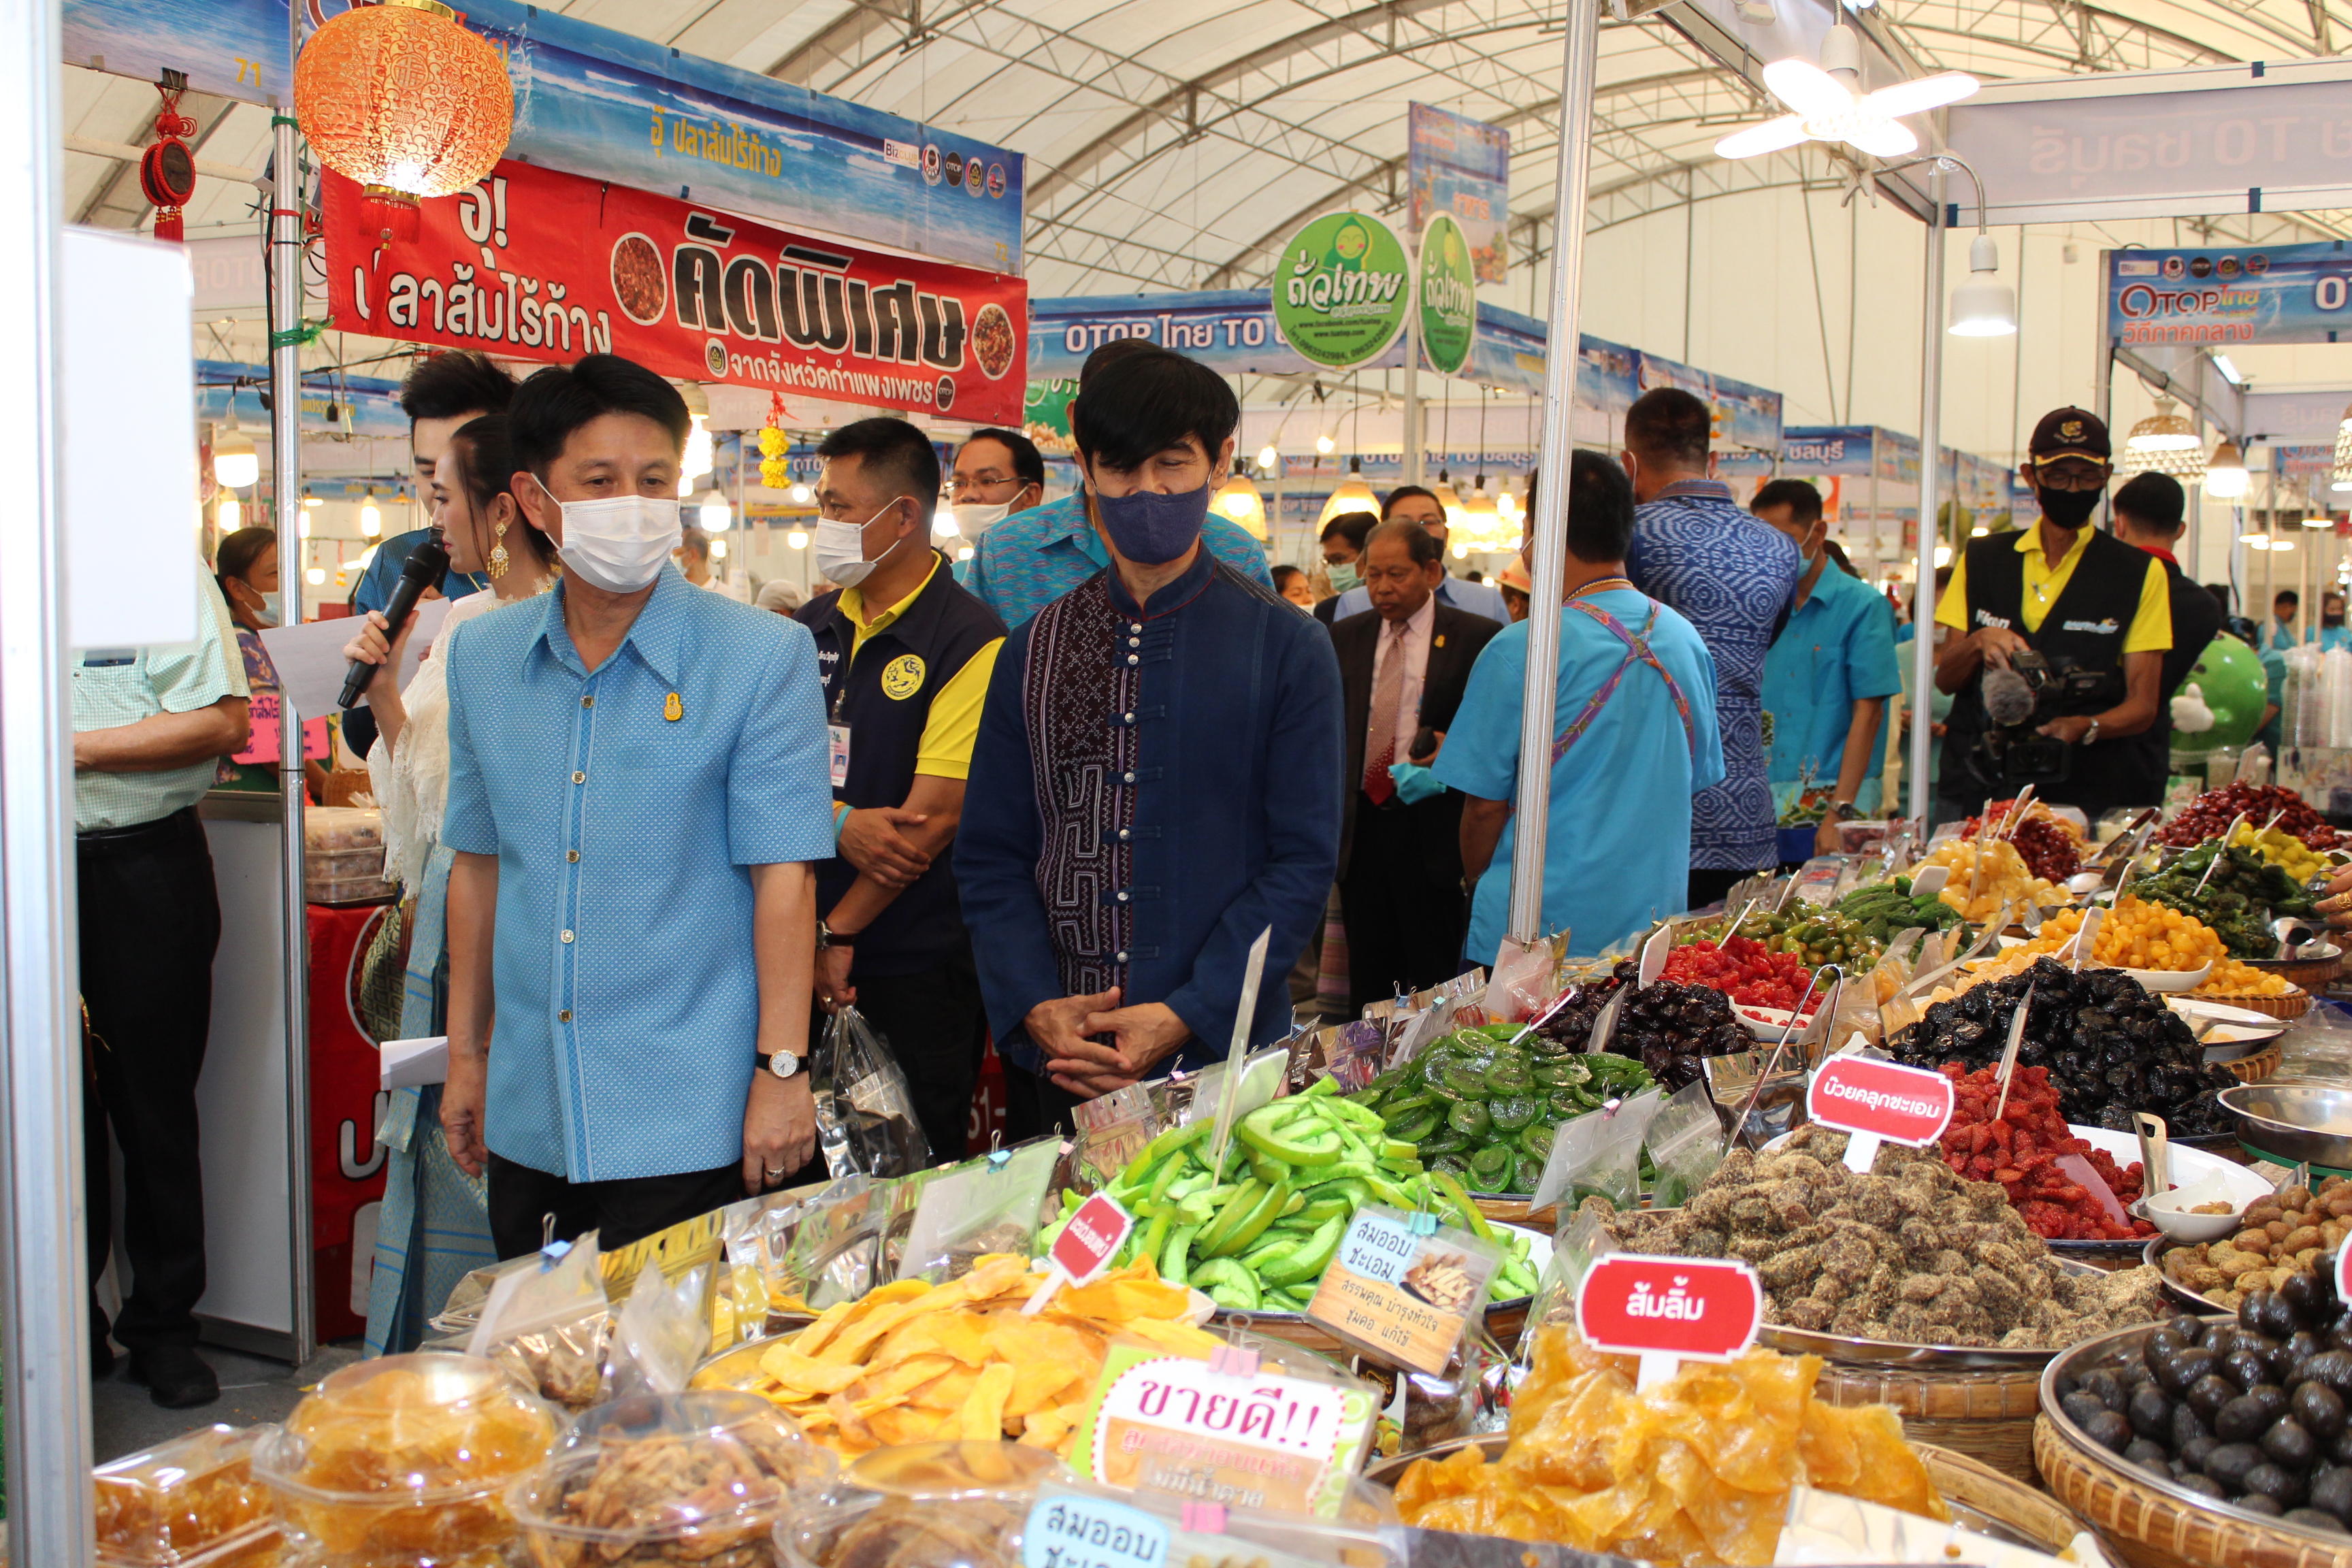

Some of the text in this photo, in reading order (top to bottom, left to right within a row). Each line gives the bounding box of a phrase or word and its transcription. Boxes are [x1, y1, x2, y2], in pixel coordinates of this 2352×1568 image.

[234, 56, 261, 88] 71
[673, 118, 781, 178] ปลาส้มไร้ก้าง
[995, 242, 1008, 262] 72
[1288, 249, 1403, 312] ถั่วเทพ
[1157, 313, 1213, 348] ไทย
[1222, 318, 1264, 347] TO
[2123, 321, 2255, 343] วิถีภาคกลาง
[730, 350, 933, 404] จากจังหวัดกำแพงเพชร
[1788, 440, 1845, 466] ชลบุรี
[1823, 1076, 1940, 1118] บ๊วยคลุกชะเอม
[1356, 1221, 1411, 1258] สมออบ
[1348, 1247, 1395, 1280] ชะเอม
[1341, 1279, 1439, 1333] สรรพคุณ บำรุงหัวใจ
[1626, 1275, 1704, 1320] ส้มลิ้ม
[1138, 1380, 1320, 1448] ขายดี!!
[1047, 1505, 1156, 1563] สมออบ
